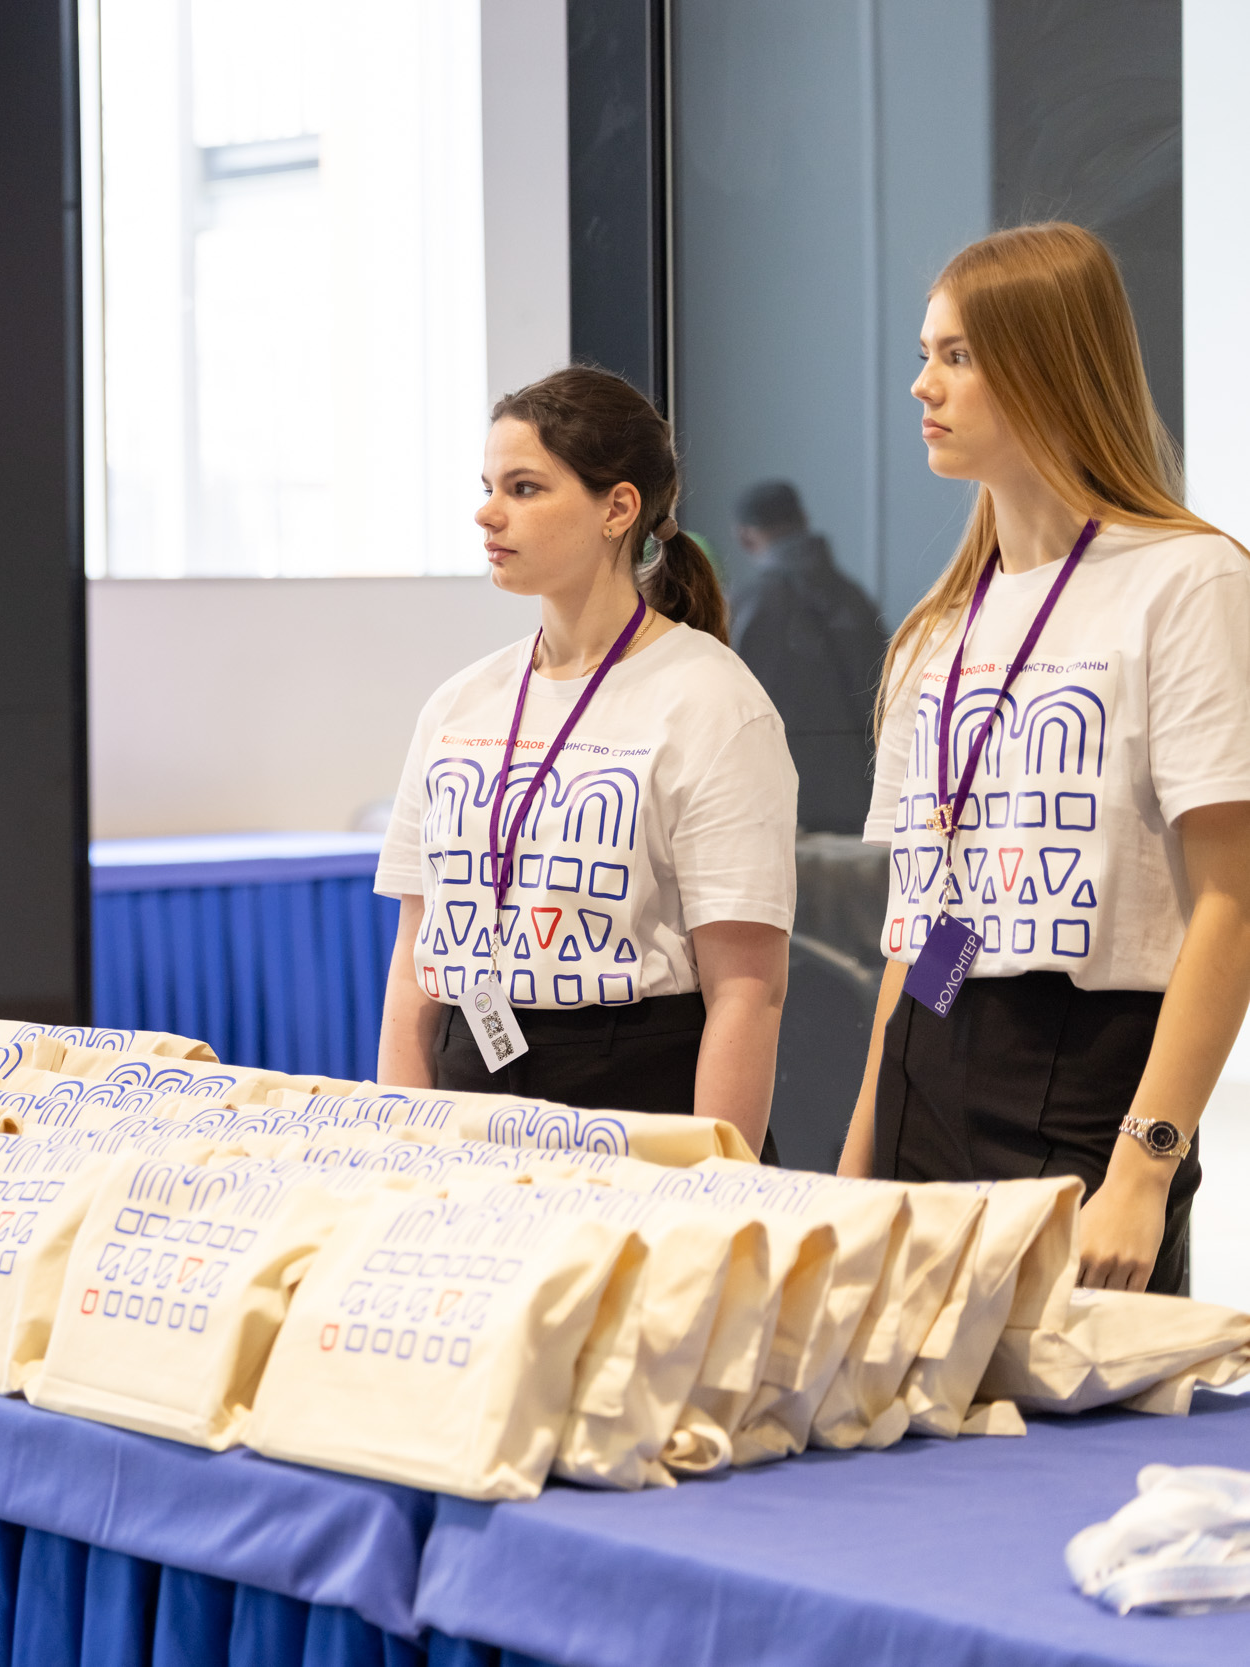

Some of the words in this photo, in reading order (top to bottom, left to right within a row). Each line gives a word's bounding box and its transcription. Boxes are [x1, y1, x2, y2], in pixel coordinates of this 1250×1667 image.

[960, 663, 996, 676] АРОДОВ
[1005, 662, 1064, 674] ЕИНСТВО
[1066, 661, 1108, 673] СТРАНЫ
[441, 735, 494, 746] ЕДИНСТВО
[494, 739, 545, 749] НАОДОВ
[561, 742, 610, 755] ДИНСТВО
[611, 748, 651, 757] СТРАНЫ
[934, 935, 978, 1014] ВОЛОНТЕР
